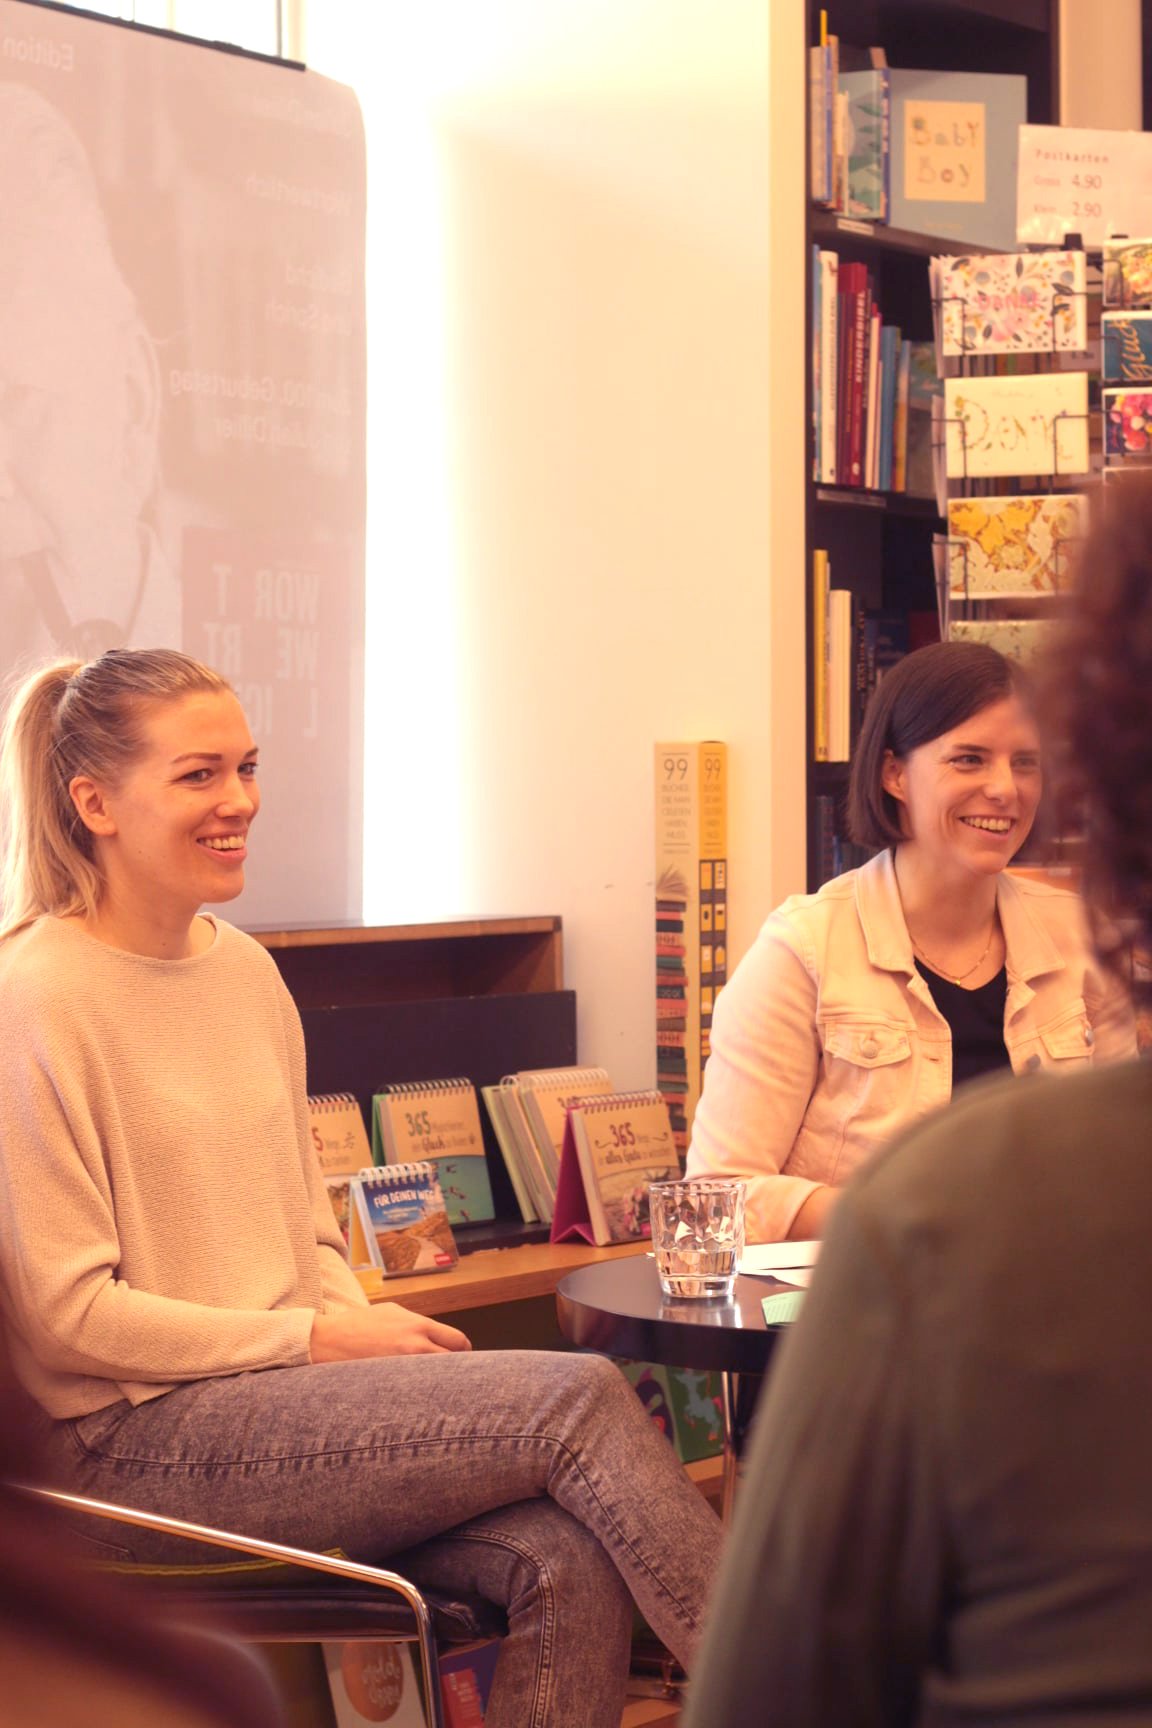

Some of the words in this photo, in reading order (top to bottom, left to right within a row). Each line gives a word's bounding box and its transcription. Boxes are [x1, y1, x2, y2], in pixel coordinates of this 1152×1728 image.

[1072, 173, 1103, 190] 4.90
[1072, 200, 1103, 219] 2.90
[855, 290, 867, 384] KINDERBIBEL
[663, 757, 689, 781] 99
[704, 757, 721, 781] 99
[405, 1110, 432, 1137] 365
[608, 1121, 635, 1148] 365
[389, 1188, 417, 1205] DEINEN
